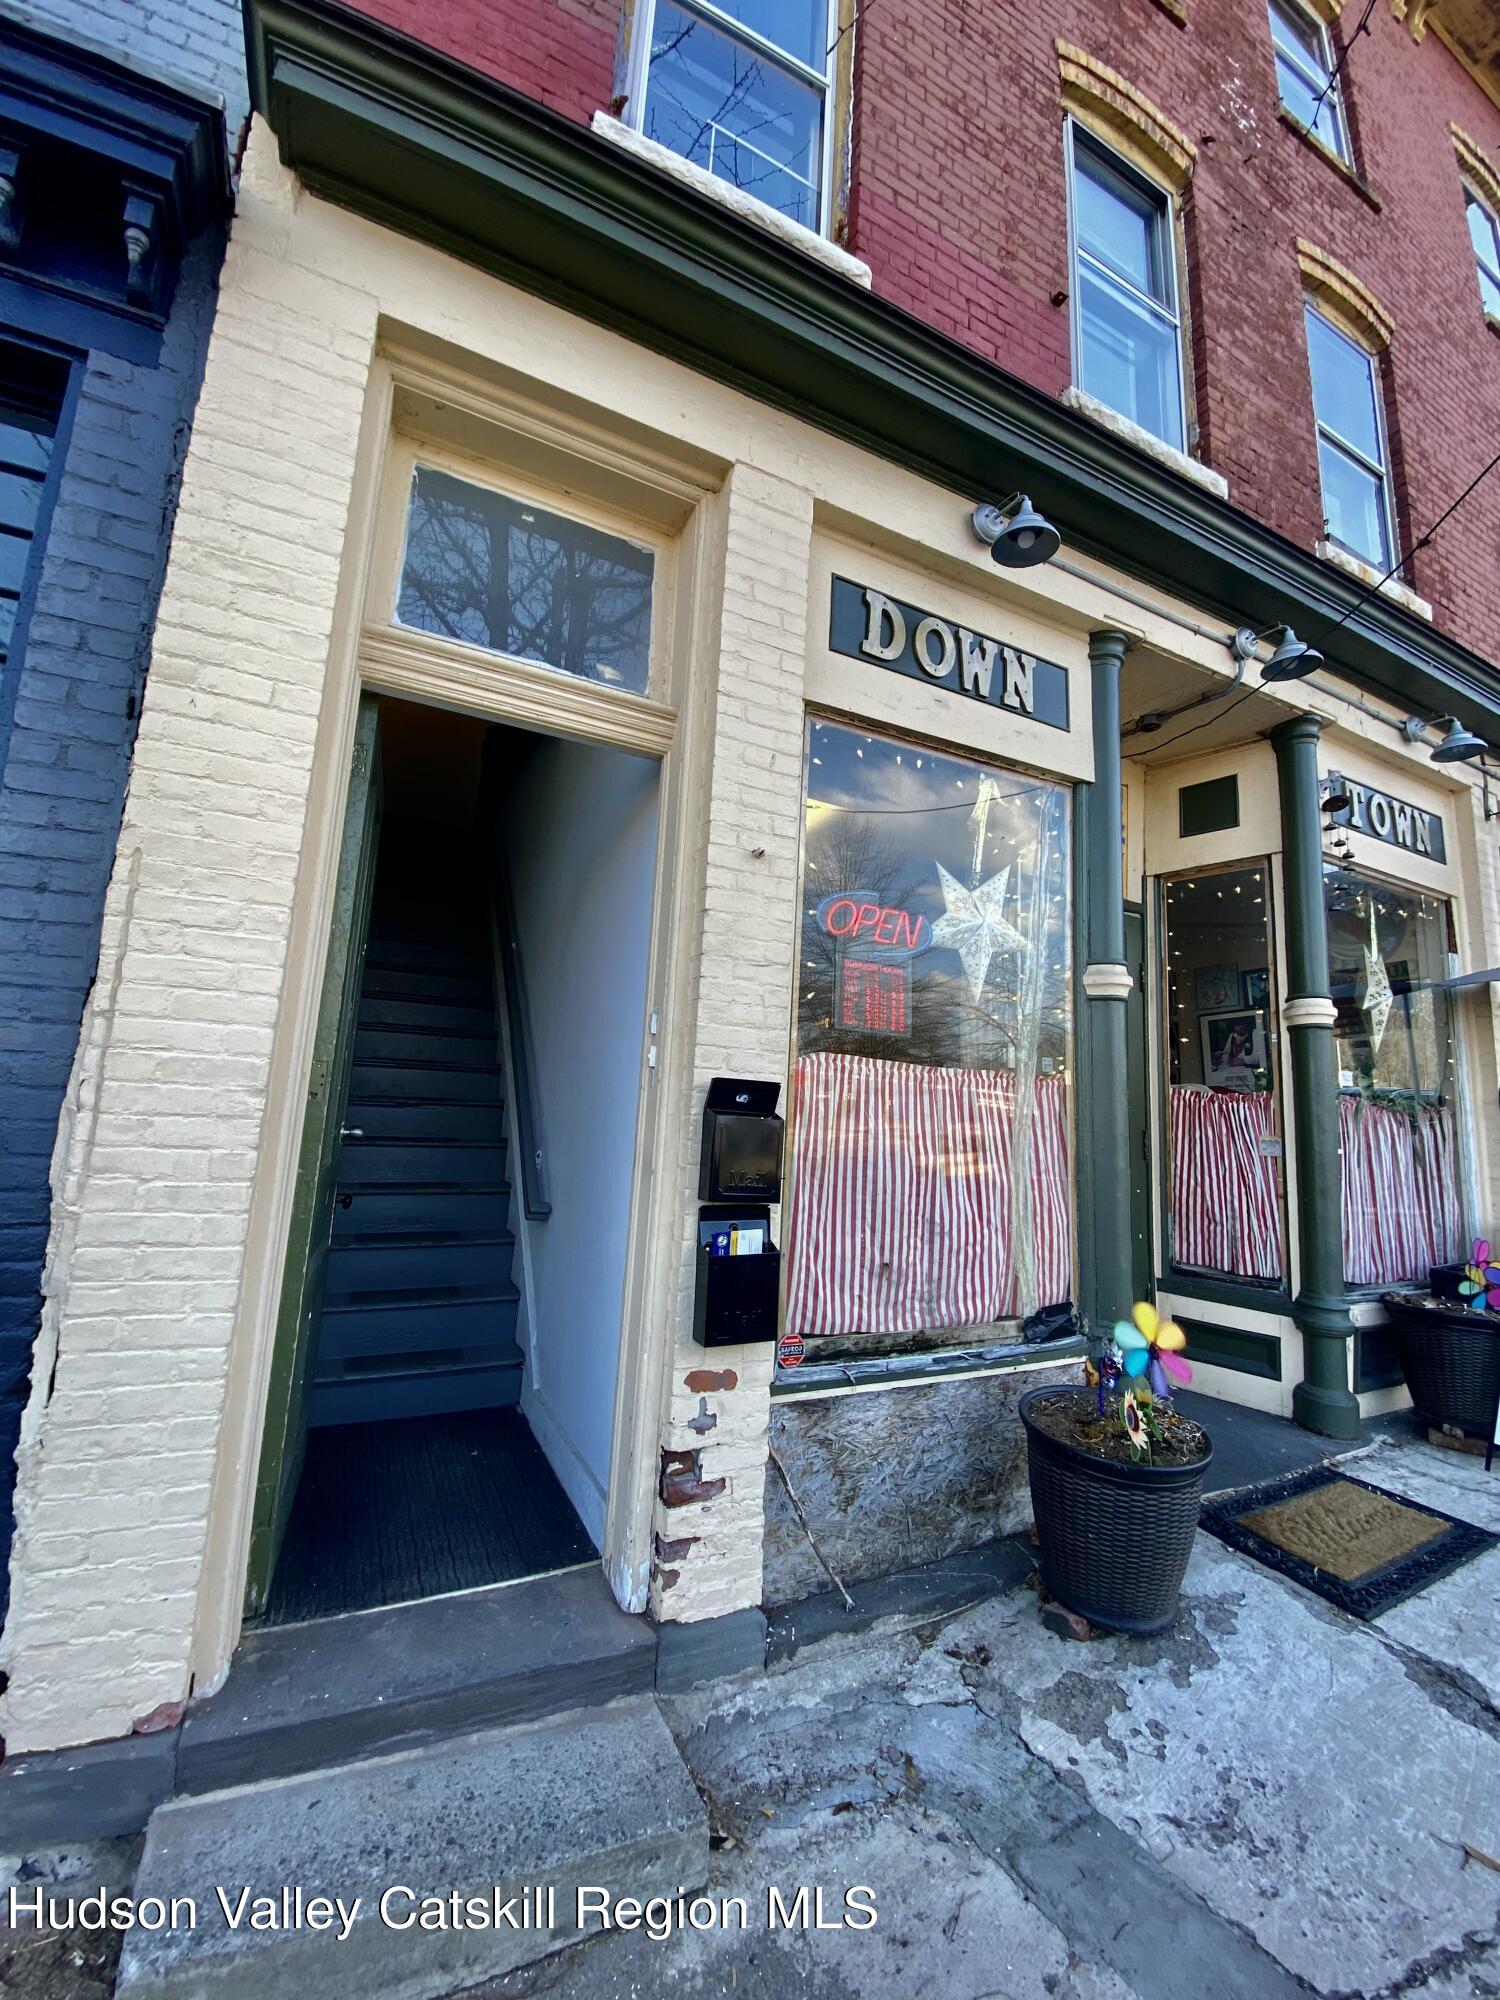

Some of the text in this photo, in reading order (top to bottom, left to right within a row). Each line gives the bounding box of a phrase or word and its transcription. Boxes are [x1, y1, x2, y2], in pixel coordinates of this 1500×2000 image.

[861, 589, 1037, 713] DOWN
[1344, 781, 1432, 856] TOWN
[827, 899, 924, 949] OPEN
[728, 1169, 768, 1188] Mail
